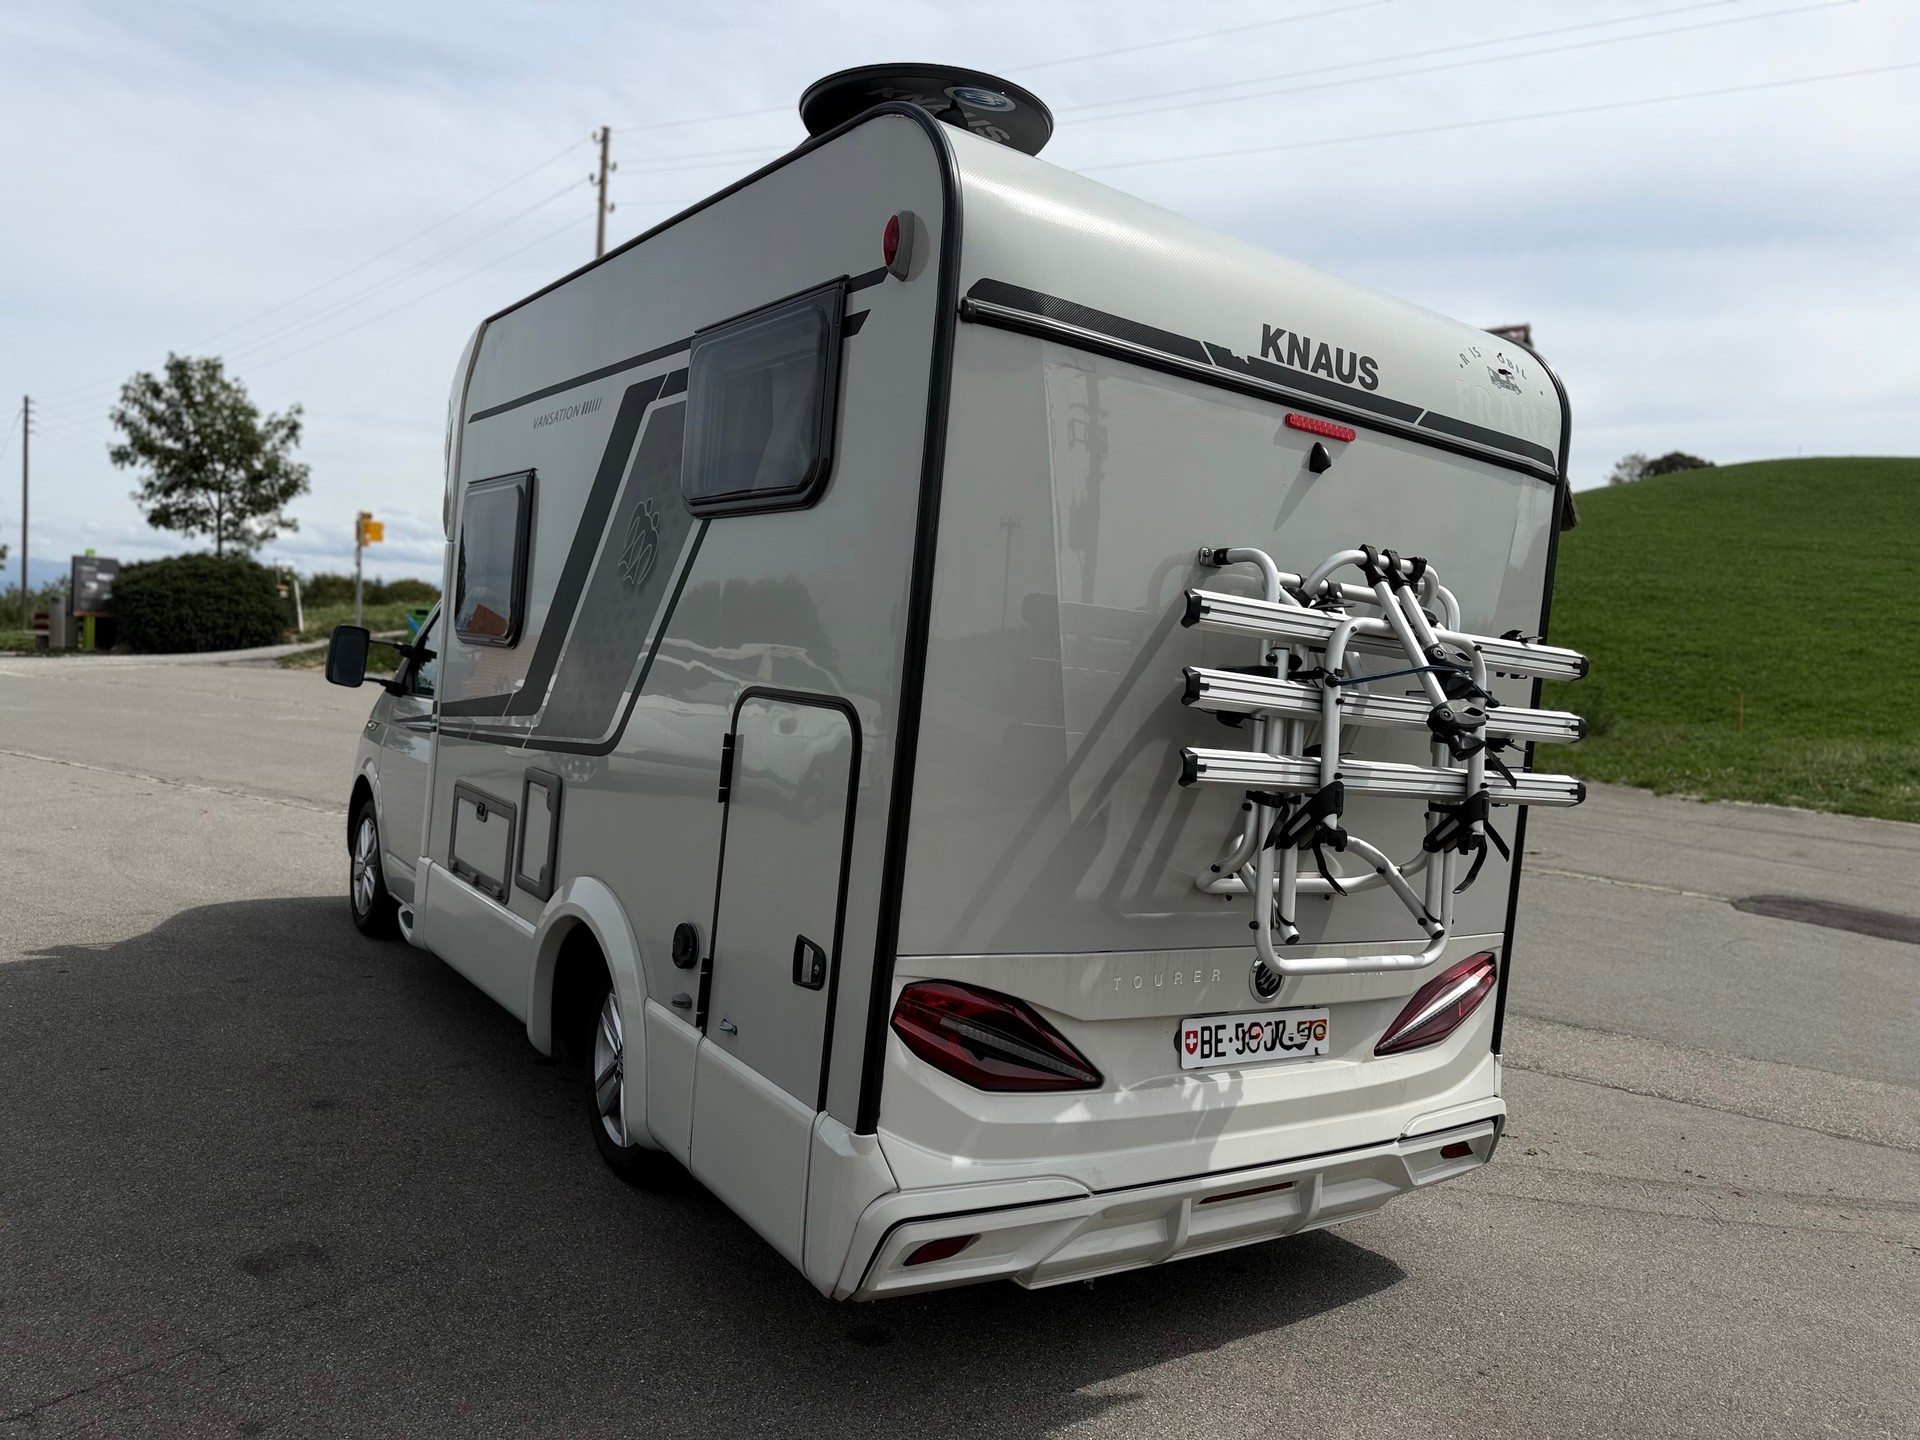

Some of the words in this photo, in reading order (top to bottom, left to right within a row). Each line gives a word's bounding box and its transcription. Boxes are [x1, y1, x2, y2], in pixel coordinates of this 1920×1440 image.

[1260, 323, 1379, 391] KNAUS
[533, 403, 581, 430] VANSATION
[1113, 968, 1222, 991] TOURER
